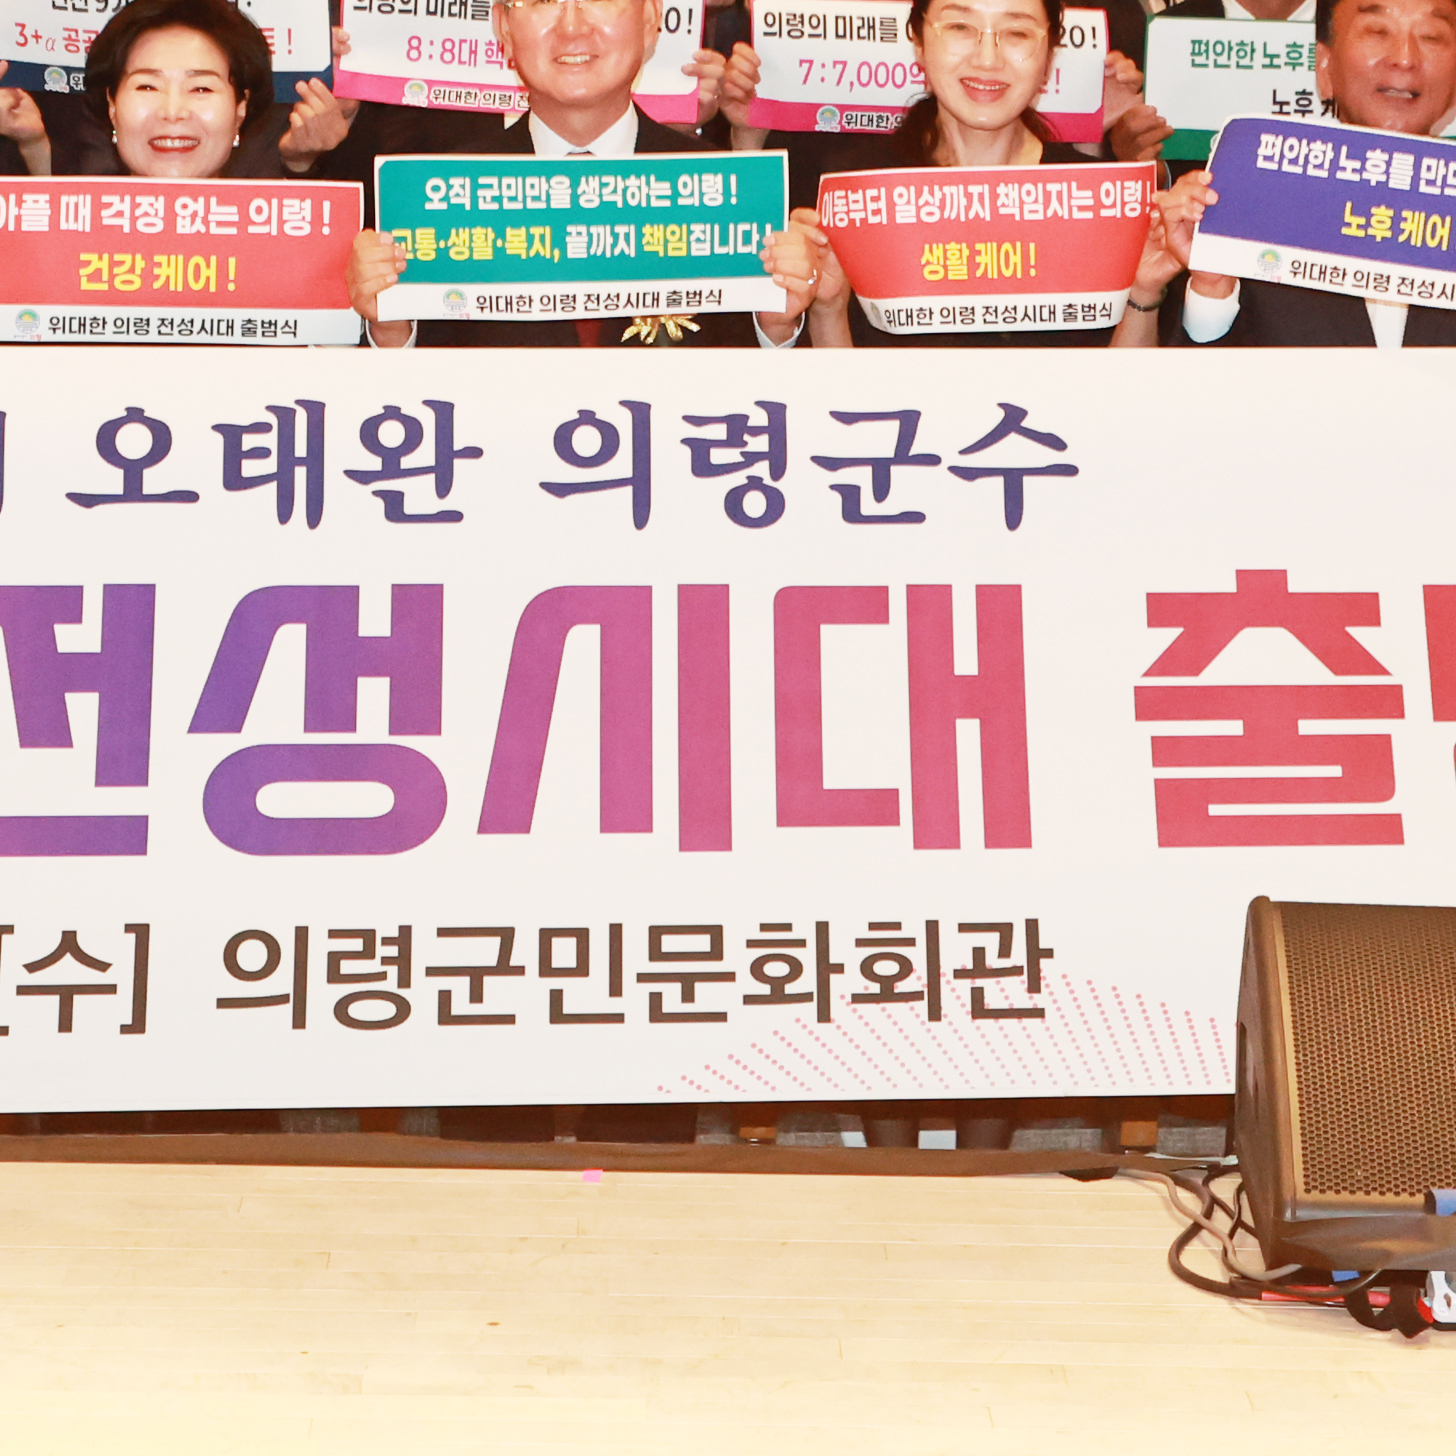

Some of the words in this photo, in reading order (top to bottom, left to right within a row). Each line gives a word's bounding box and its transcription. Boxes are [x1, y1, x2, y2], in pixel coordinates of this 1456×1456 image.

[763, 12, 828, 38] 의령의
[835, 14, 898, 43] 미래를
[1190, 39, 1255, 69] 편안한
[1257, 132, 1332, 173] 편안한
[1338, 148, 1413, 192] 노후를
[425, 178, 472, 211] 오직
[478, 176, 572, 209] 군민만을
[578, 174, 671, 207] 생각하는
[821, 187, 888, 229] 이동부터
[894, 184, 991, 223] 일상까지
[998, 183, 1094, 221] 책임지는
[60, 194, 91, 232] 때
[102, 196, 164, 233] 걱정
[174, 197, 240, 234] 없는
[1342, 200, 1394, 244] 노후
[565, 225, 636, 258] 끝까지
[79, 252, 146, 290] 건강
[921, 244, 970, 280] 생활
[476, 292, 534, 314] 위대한
[539, 291, 578, 312] 의령
[583, 290, 660, 312] 전성시대
[665, 288, 722, 309] 출범식
[67, 400, 480, 531] 오태완
[539, 404, 1079, 535] 의령군수
[215, 915, 1054, 1029] 의령군민문화회관
